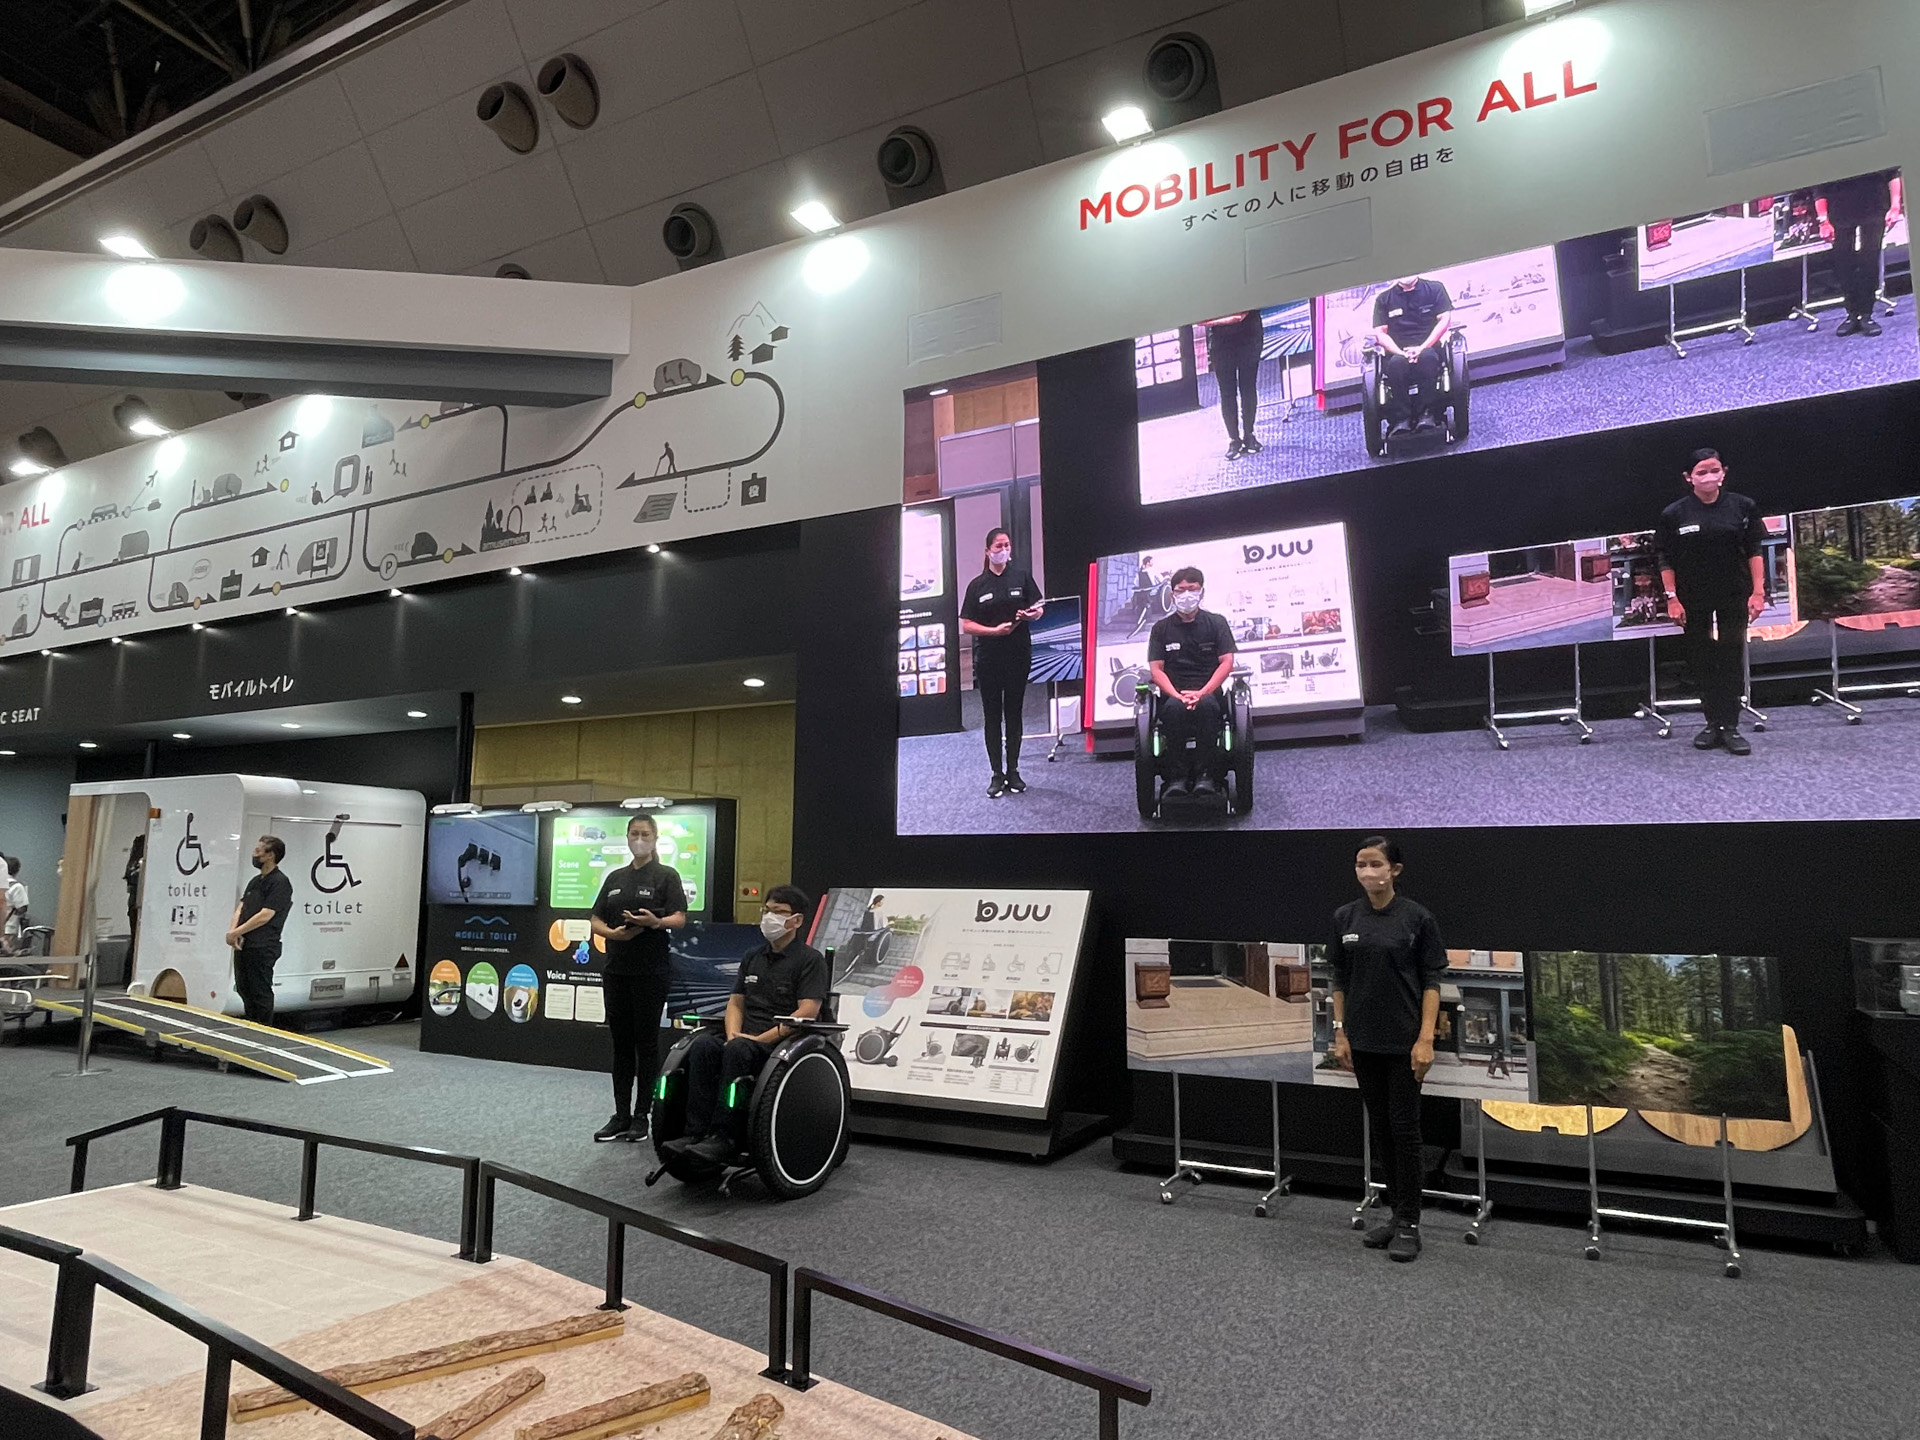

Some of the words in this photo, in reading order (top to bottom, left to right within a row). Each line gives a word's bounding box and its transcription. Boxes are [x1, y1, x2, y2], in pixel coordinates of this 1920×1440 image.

[1080, 133, 1317, 231] MOBILITY
[1338, 97, 1454, 160] FOR
[1476, 60, 1598, 123] ALL
[1181, 147, 1454, 232] すべての人に移動の自由を
[19, 502, 50, 531] ALL
[209, 675, 294, 700] モバイルトイレ
[11, 707, 41, 723] SEAT
[168, 882, 207, 897] toilet
[304, 900, 363, 914] toilet
[546, 969, 567, 980] Voice
[314, 984, 344, 993] TOYOTA
